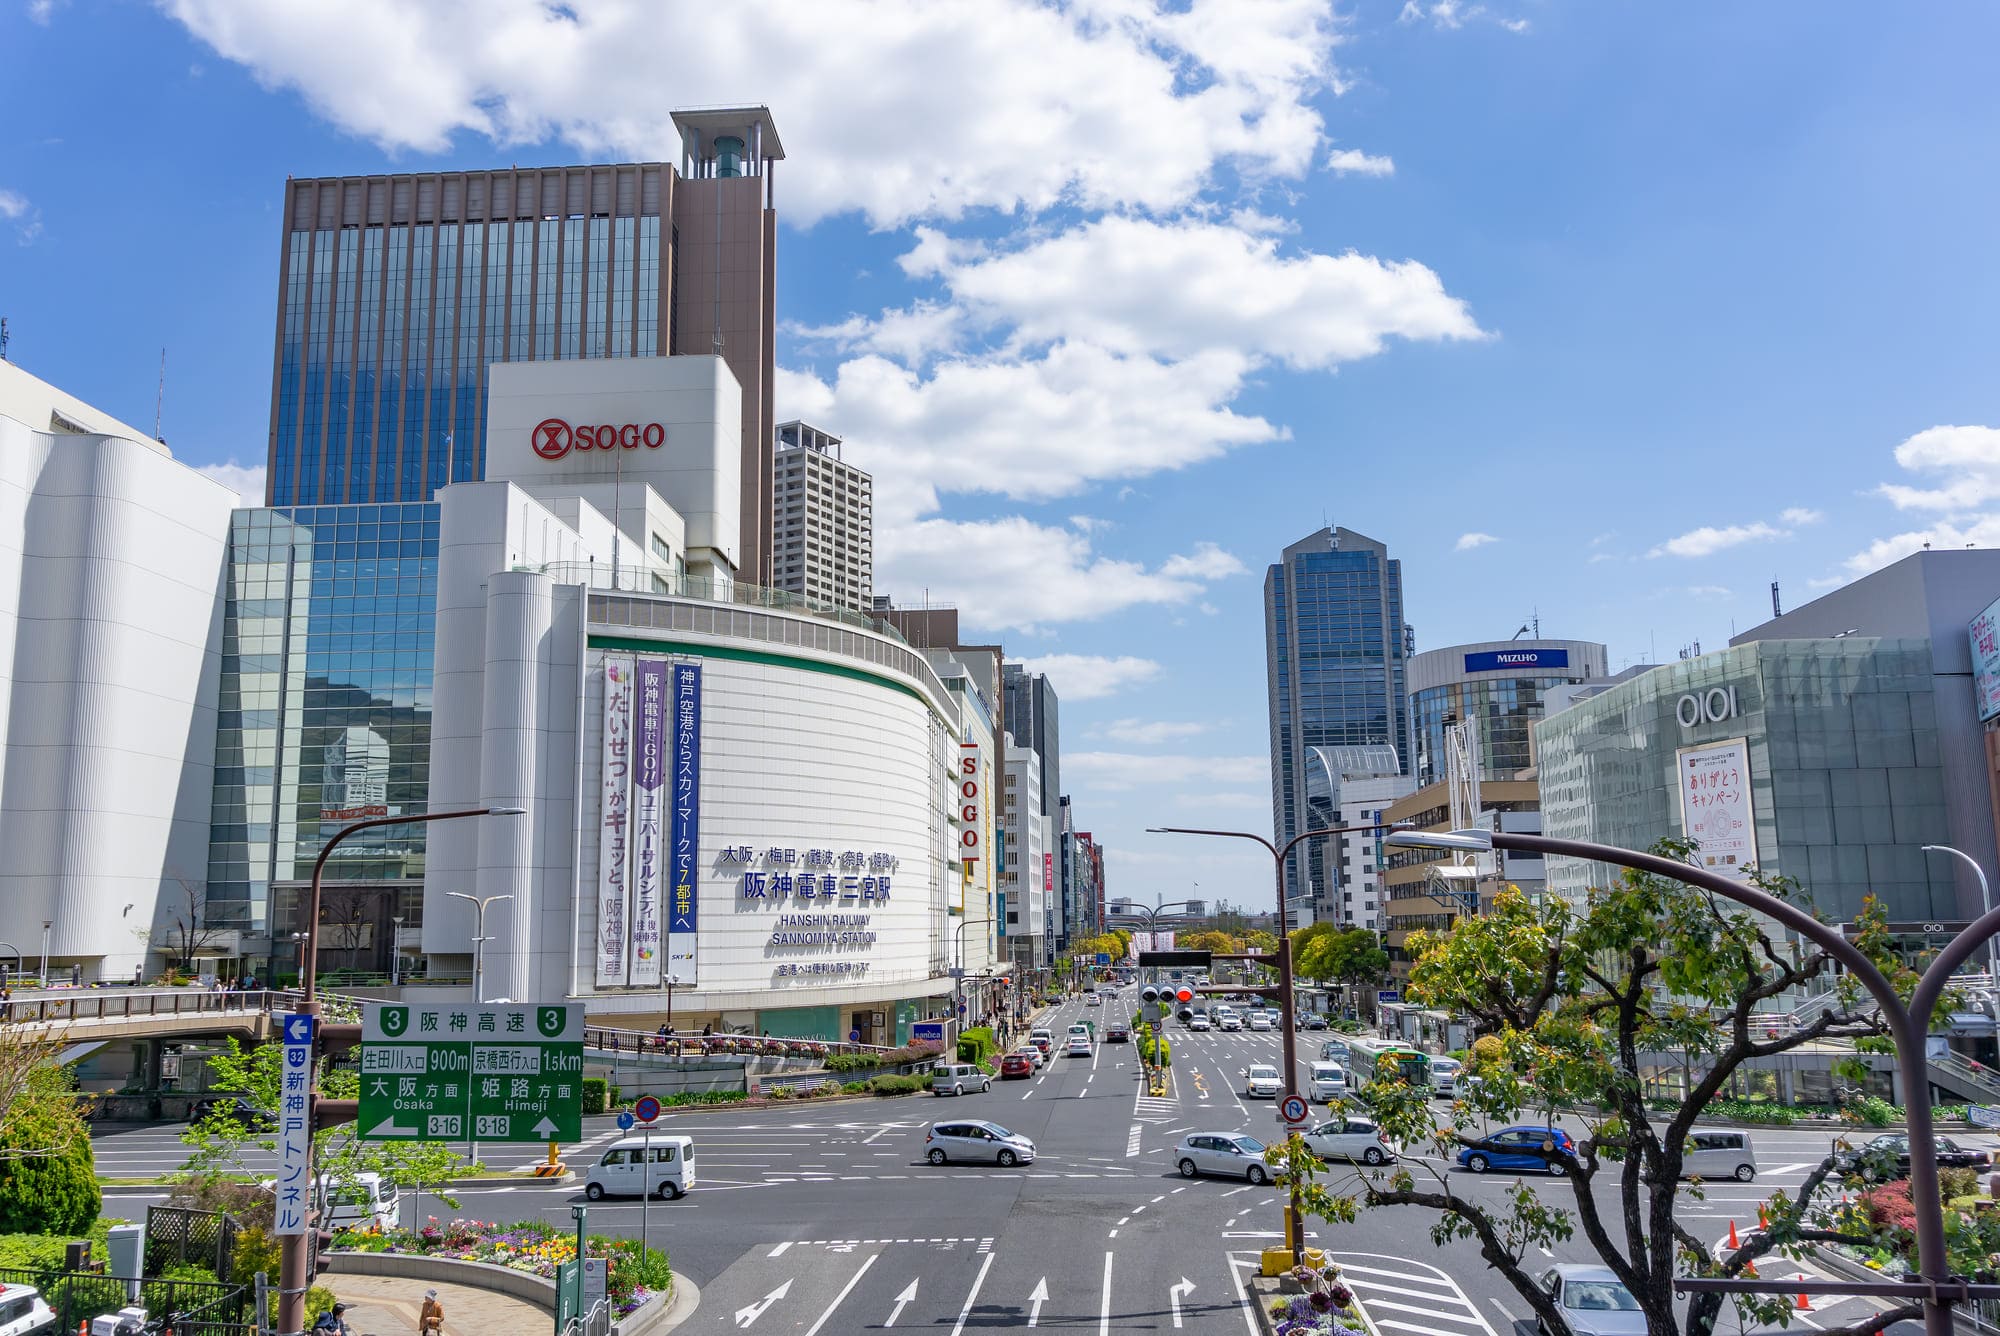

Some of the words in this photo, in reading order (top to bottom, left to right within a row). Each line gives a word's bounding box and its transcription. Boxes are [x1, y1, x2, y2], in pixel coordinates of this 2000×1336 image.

[575, 422, 665, 450] SOGO
[1497, 653, 1538, 663] MIZUHO
[1690, 768, 1739, 791] ありがとう
[962, 757, 978, 847] SOGO
[1691, 790, 1741, 808] キャンペーン
[744, 872, 891, 900] 阪神電車三宮駅
[781, 914, 830, 927] HANSHIN
[833, 914, 871, 926] RAILWAY
[604, 898, 623, 976] 阪神電車
[773, 932, 838, 945] SANNOMIYA
[842, 932, 877, 943] STATION
[387, 1010, 401, 1030] 3
[420, 1012, 525, 1033] 阪神高速
[544, 1010, 558, 1030] 3
[290, 1051, 303, 1062] 32
[364, 1050, 425, 1070] 生田川入口
[431, 1050, 468, 1071] 900m
[475, 1050, 538, 1071] 京橋西行入口
[393, 1099, 433, 1110] Osaka
[505, 1099, 547, 1113] Himeji
[430, 1117, 459, 1134] 3-16
[478, 1117, 508, 1134] 3-18
[279, 1071, 305, 1229] 新神戸トンネル
